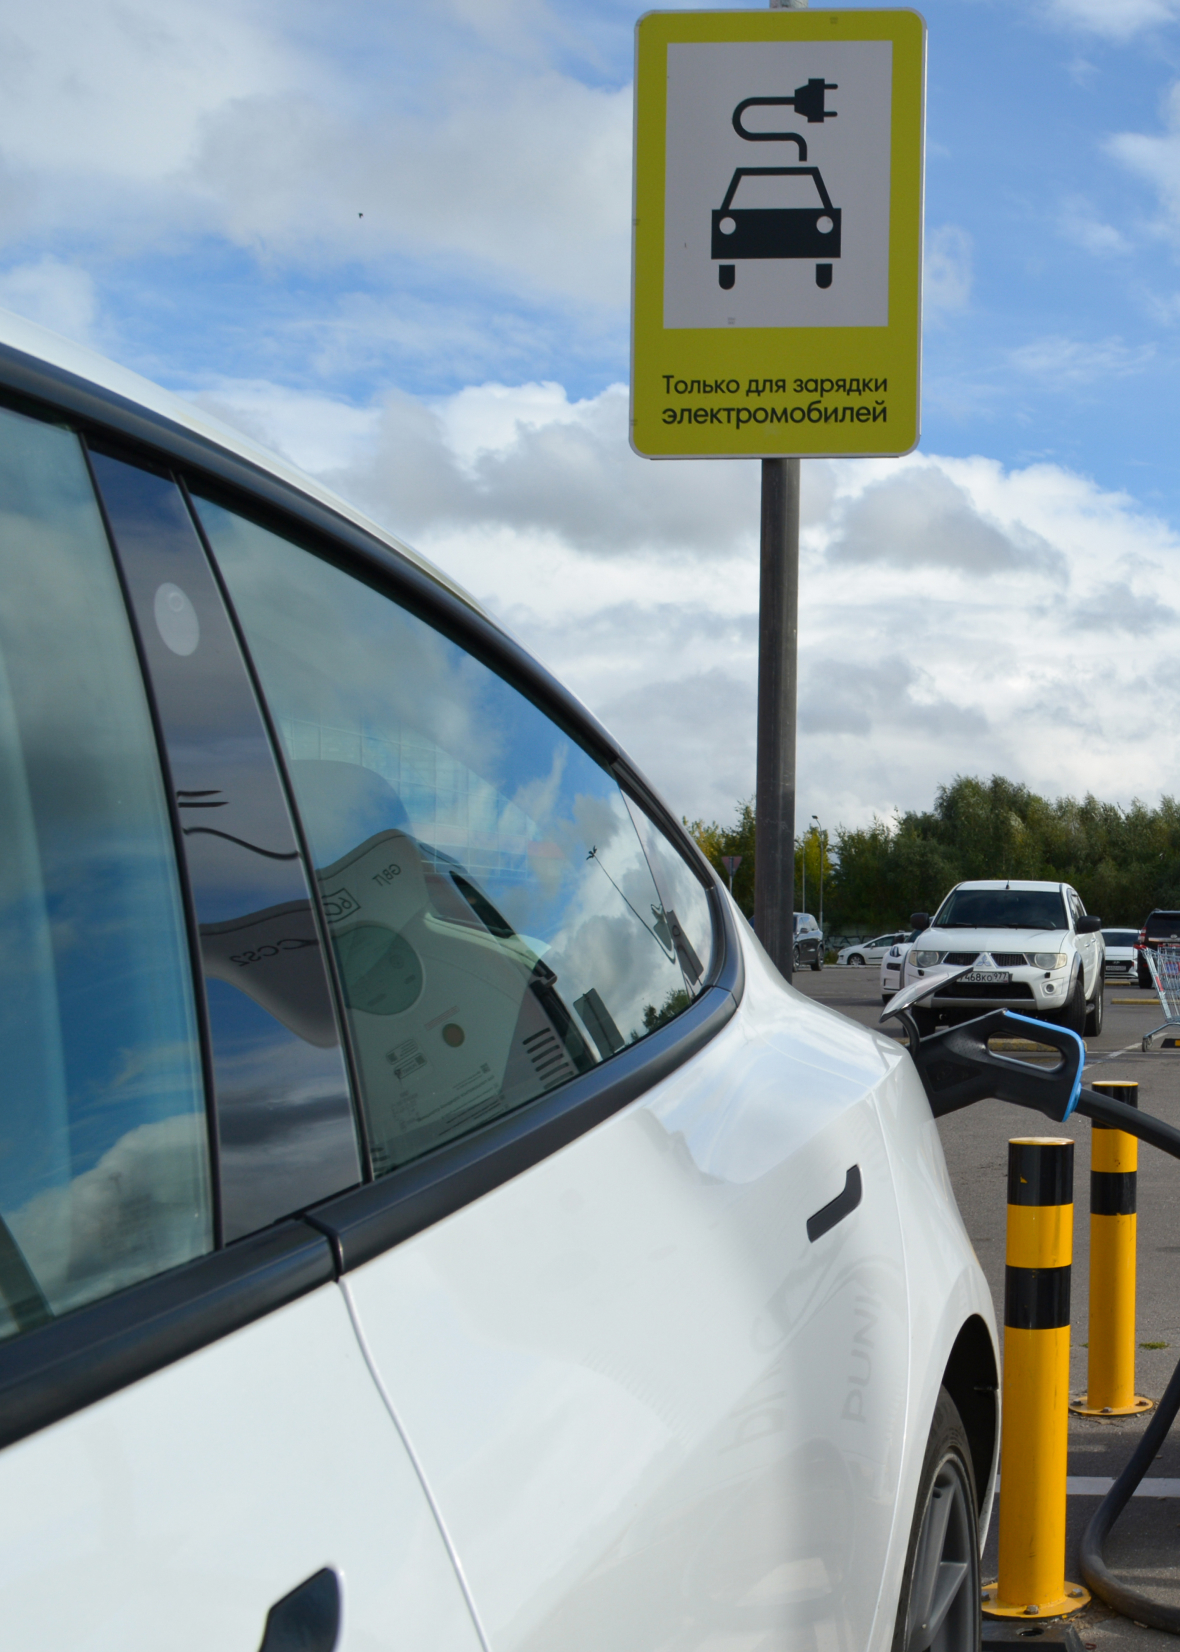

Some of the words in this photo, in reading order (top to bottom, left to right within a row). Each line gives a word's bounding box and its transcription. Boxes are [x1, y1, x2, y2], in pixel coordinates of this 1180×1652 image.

[662, 374, 740, 395] Только
[746, 378, 786, 397] для
[793, 378, 888, 397] зарядки
[662, 400, 887, 430] электромобилей
